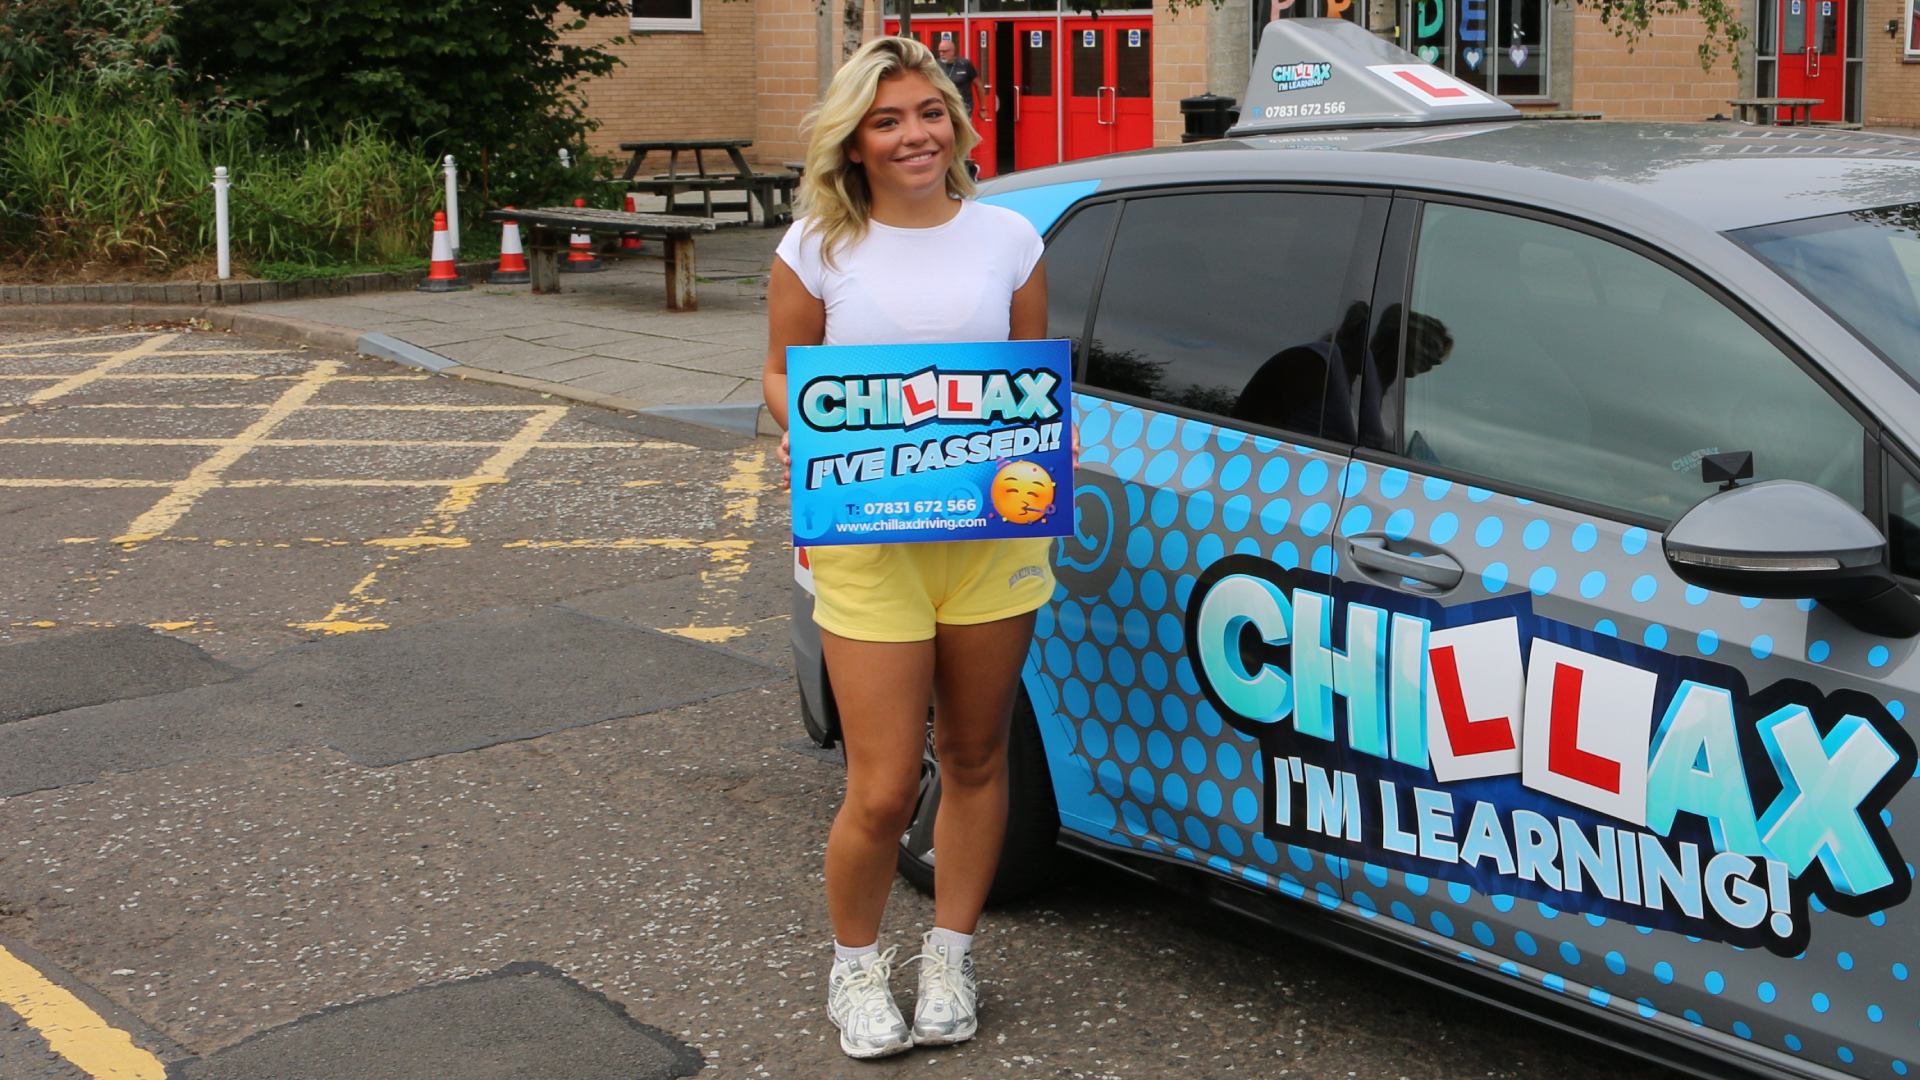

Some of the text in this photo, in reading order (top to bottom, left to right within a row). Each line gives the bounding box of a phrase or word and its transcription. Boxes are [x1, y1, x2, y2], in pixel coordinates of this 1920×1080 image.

[1272, 62, 1331, 82] CHILLAX
[1392, 71, 1469, 98] L
[1265, 104, 1298, 118] 07831
[1300, 103, 1321, 116] 672
[1324, 101, 1346, 114] 566
[802, 371, 1059, 426] CHILLAX
[808, 421, 1063, 489] I'VE PASSED!!
[846, 498, 977, 515] T: 07831 672 566
[836, 516, 987, 532] www.chillaxdriving.com
[1196, 573, 1900, 896] CHILLAX
[1273, 755, 1795, 939] I'M LEARNING!
